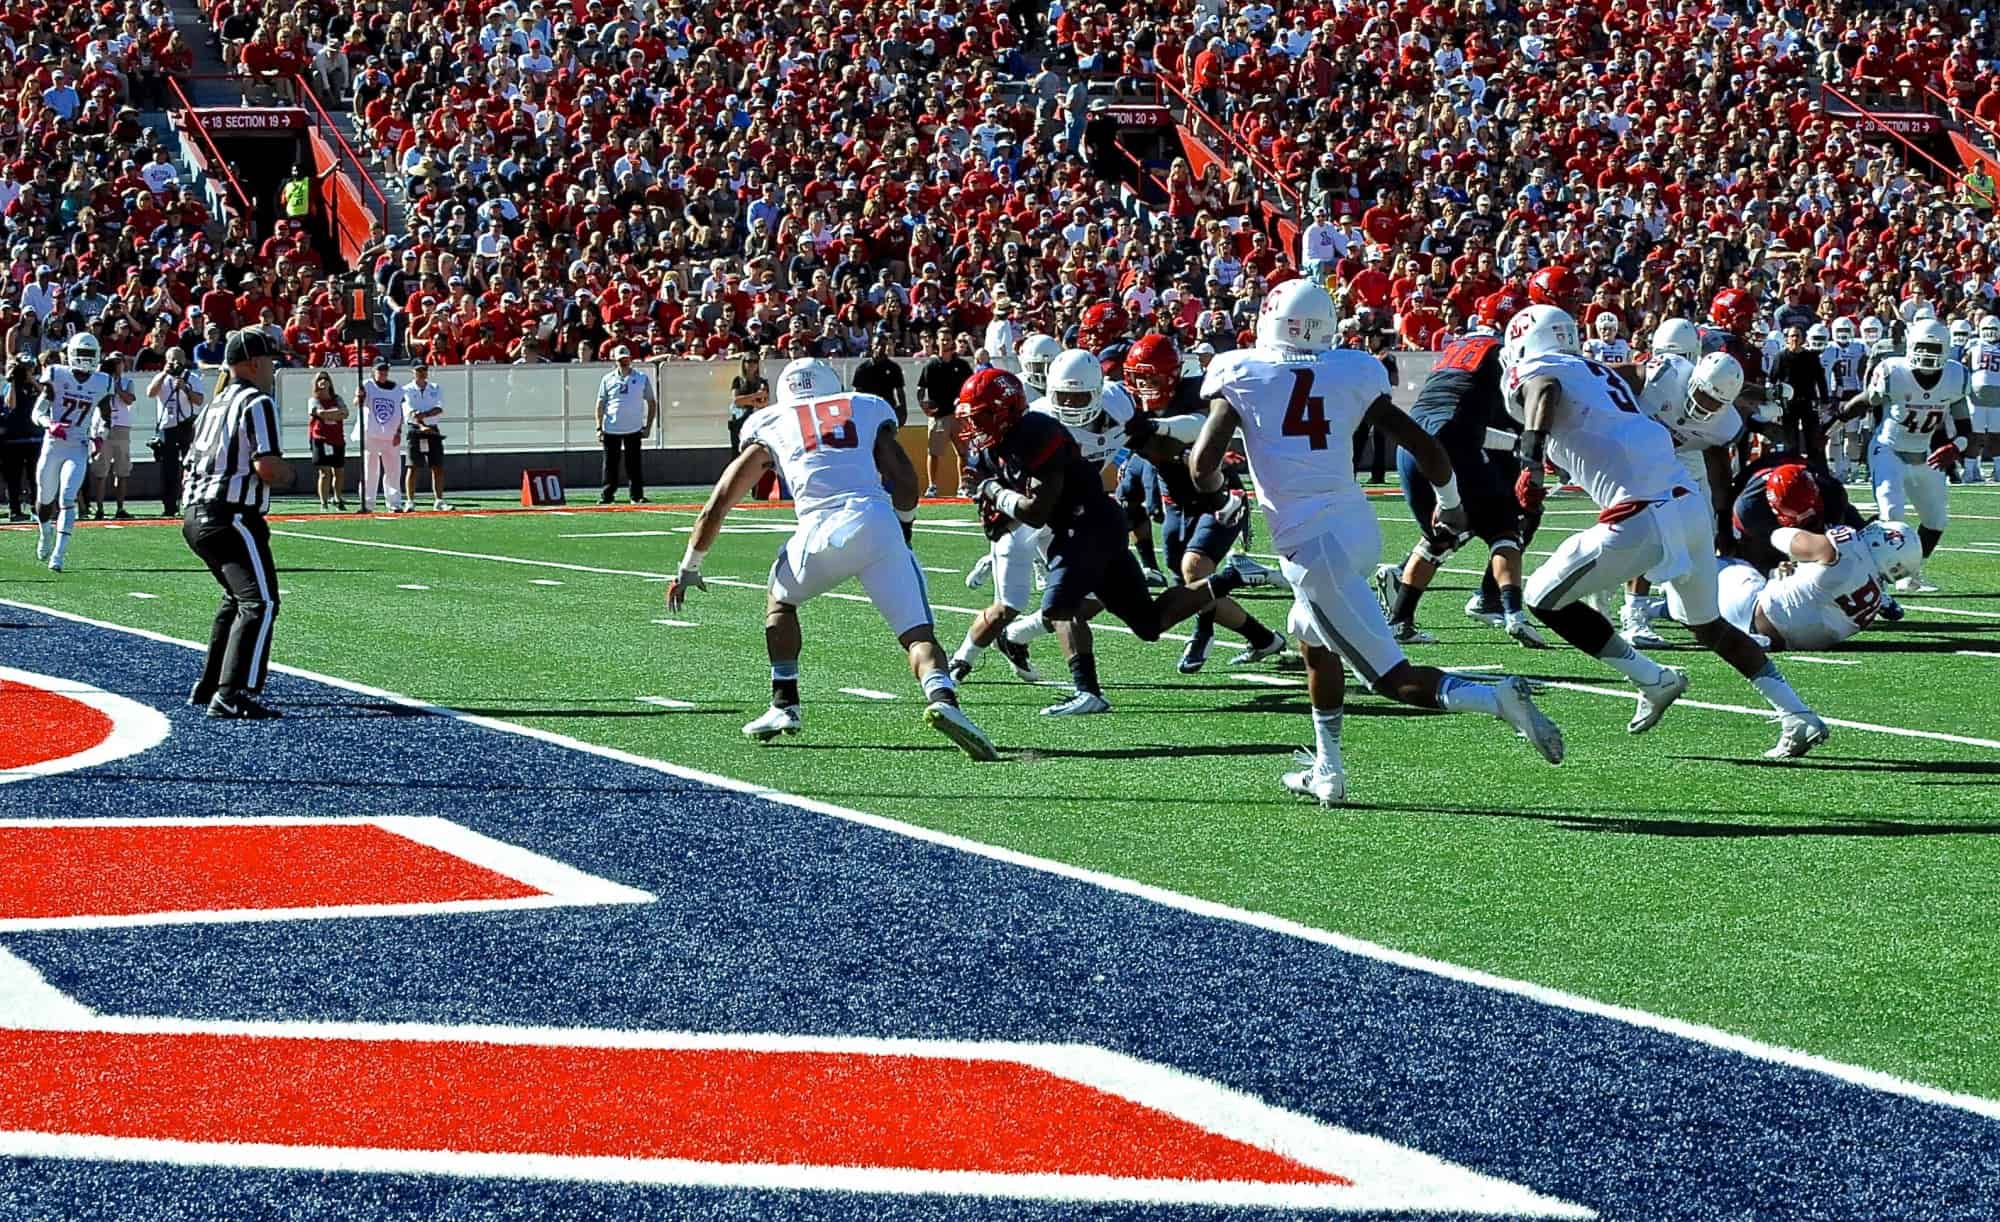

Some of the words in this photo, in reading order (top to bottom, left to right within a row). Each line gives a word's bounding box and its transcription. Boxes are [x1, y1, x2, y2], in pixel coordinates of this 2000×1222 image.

[212, 116, 222, 128] 18
[225, 116, 265, 128] SECTION
[269, 115, 279, 127] 19
[1135, 112, 1147, 124] 20
[1864, 120, 1875, 131] 20
[1911, 120, 1921, 132] 21
[352, 288, 366, 320] 1
[1583, 359, 1641, 415] 3
[60, 397, 93, 428] 27
[1281, 367, 1332, 451] 4
[1902, 410, 1945, 434] 40
[795, 398, 859, 452] 18
[533, 475, 561, 501] 10
